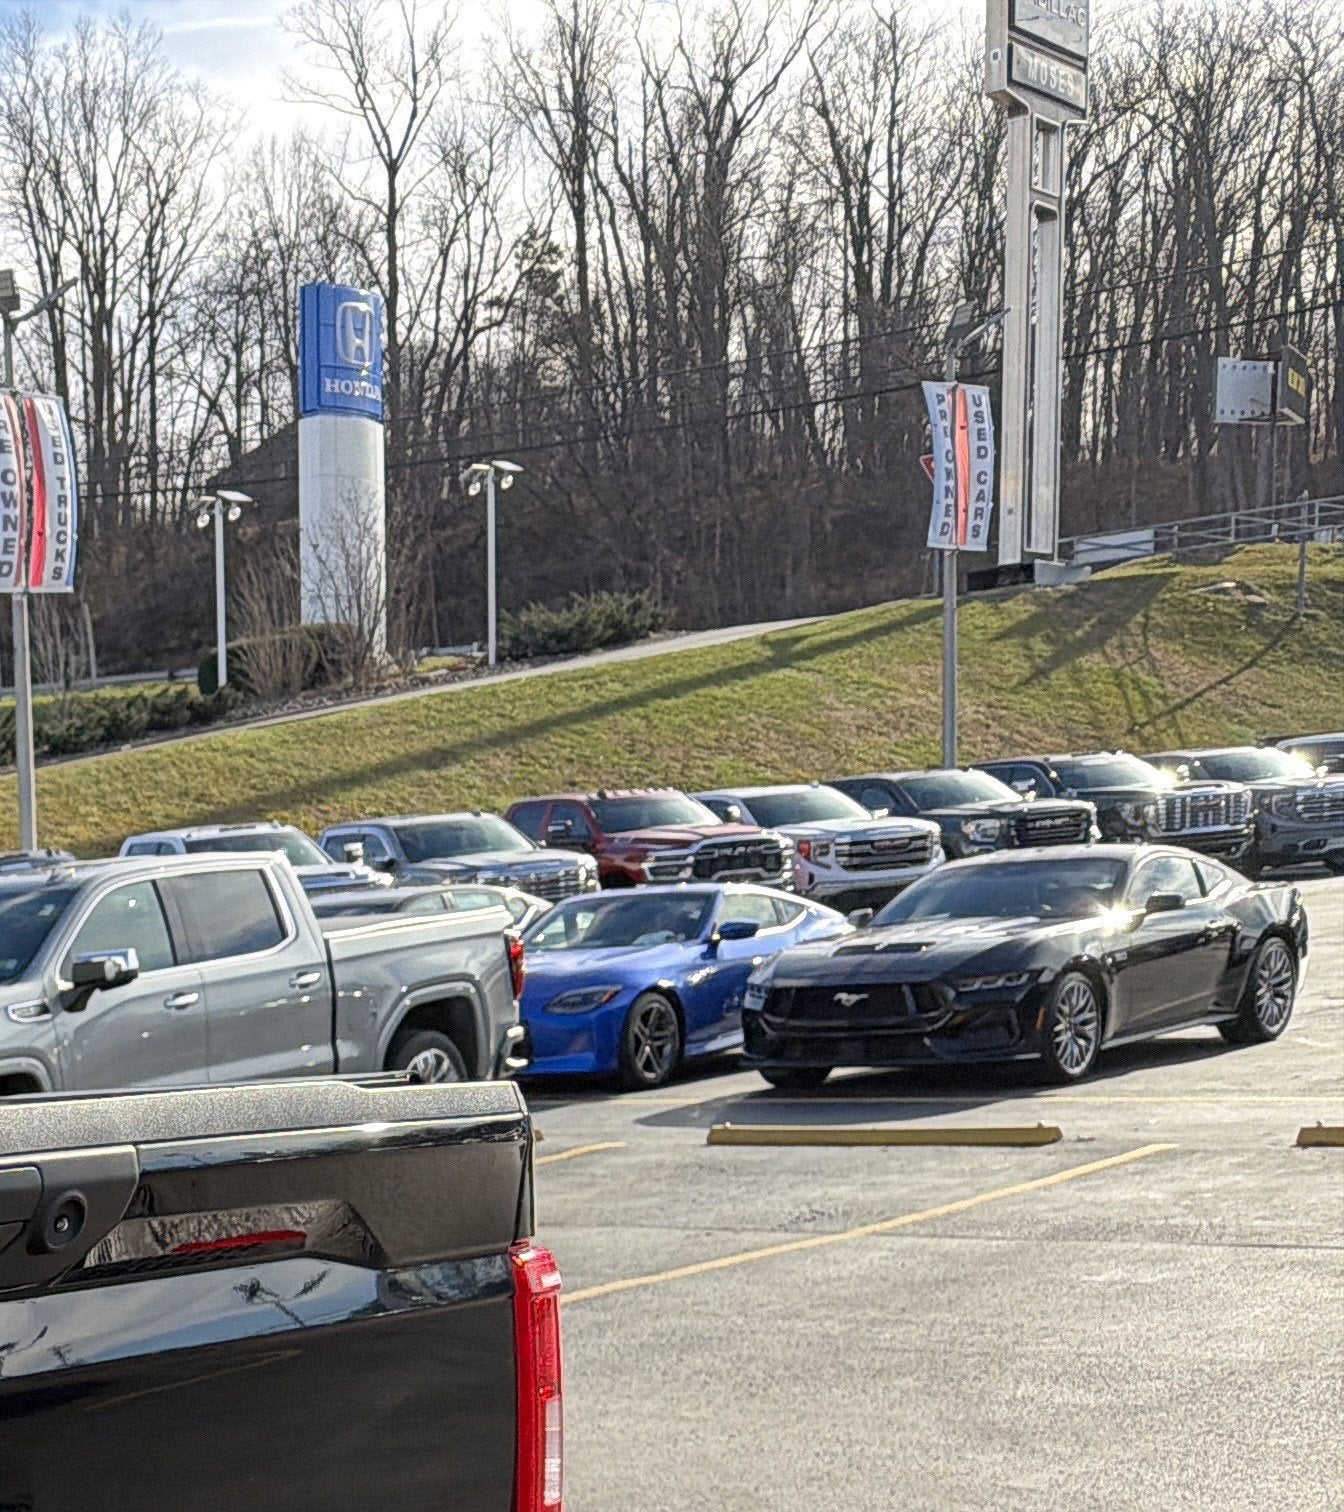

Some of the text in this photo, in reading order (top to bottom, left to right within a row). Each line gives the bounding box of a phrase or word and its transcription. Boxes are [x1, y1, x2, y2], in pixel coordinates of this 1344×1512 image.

[1027, 56, 1074, 97] MOSES
[937, 393, 954, 537] PRE OWNED
[972, 395, 988, 538] USED CARS
[51, 476, 68, 581] TRUCKS
